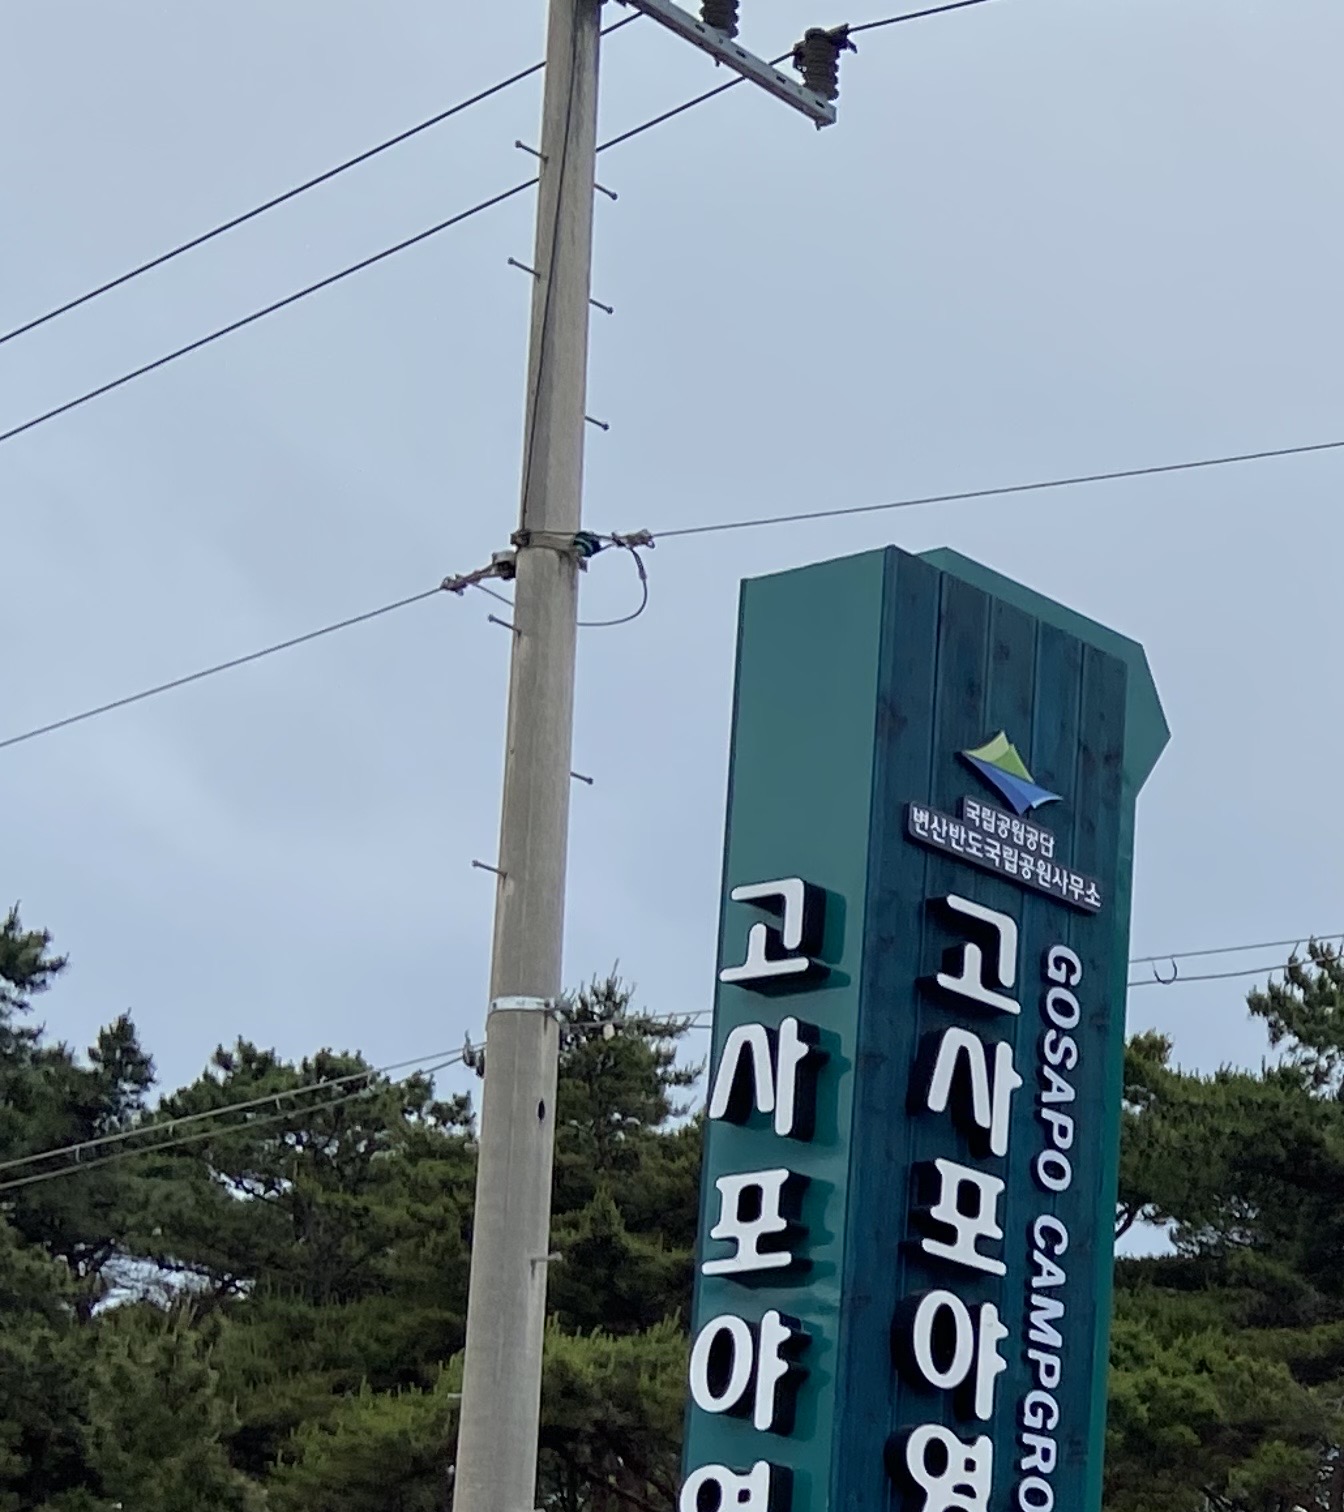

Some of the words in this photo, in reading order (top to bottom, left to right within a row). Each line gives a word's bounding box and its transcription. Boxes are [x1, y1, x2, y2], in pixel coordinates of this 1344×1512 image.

[911, 806, 1102, 908] 변산반도국립공원사무소
[965, 799, 1056, 859] 국립공원공단
[1034, 944, 1083, 1193] GOSAPO
